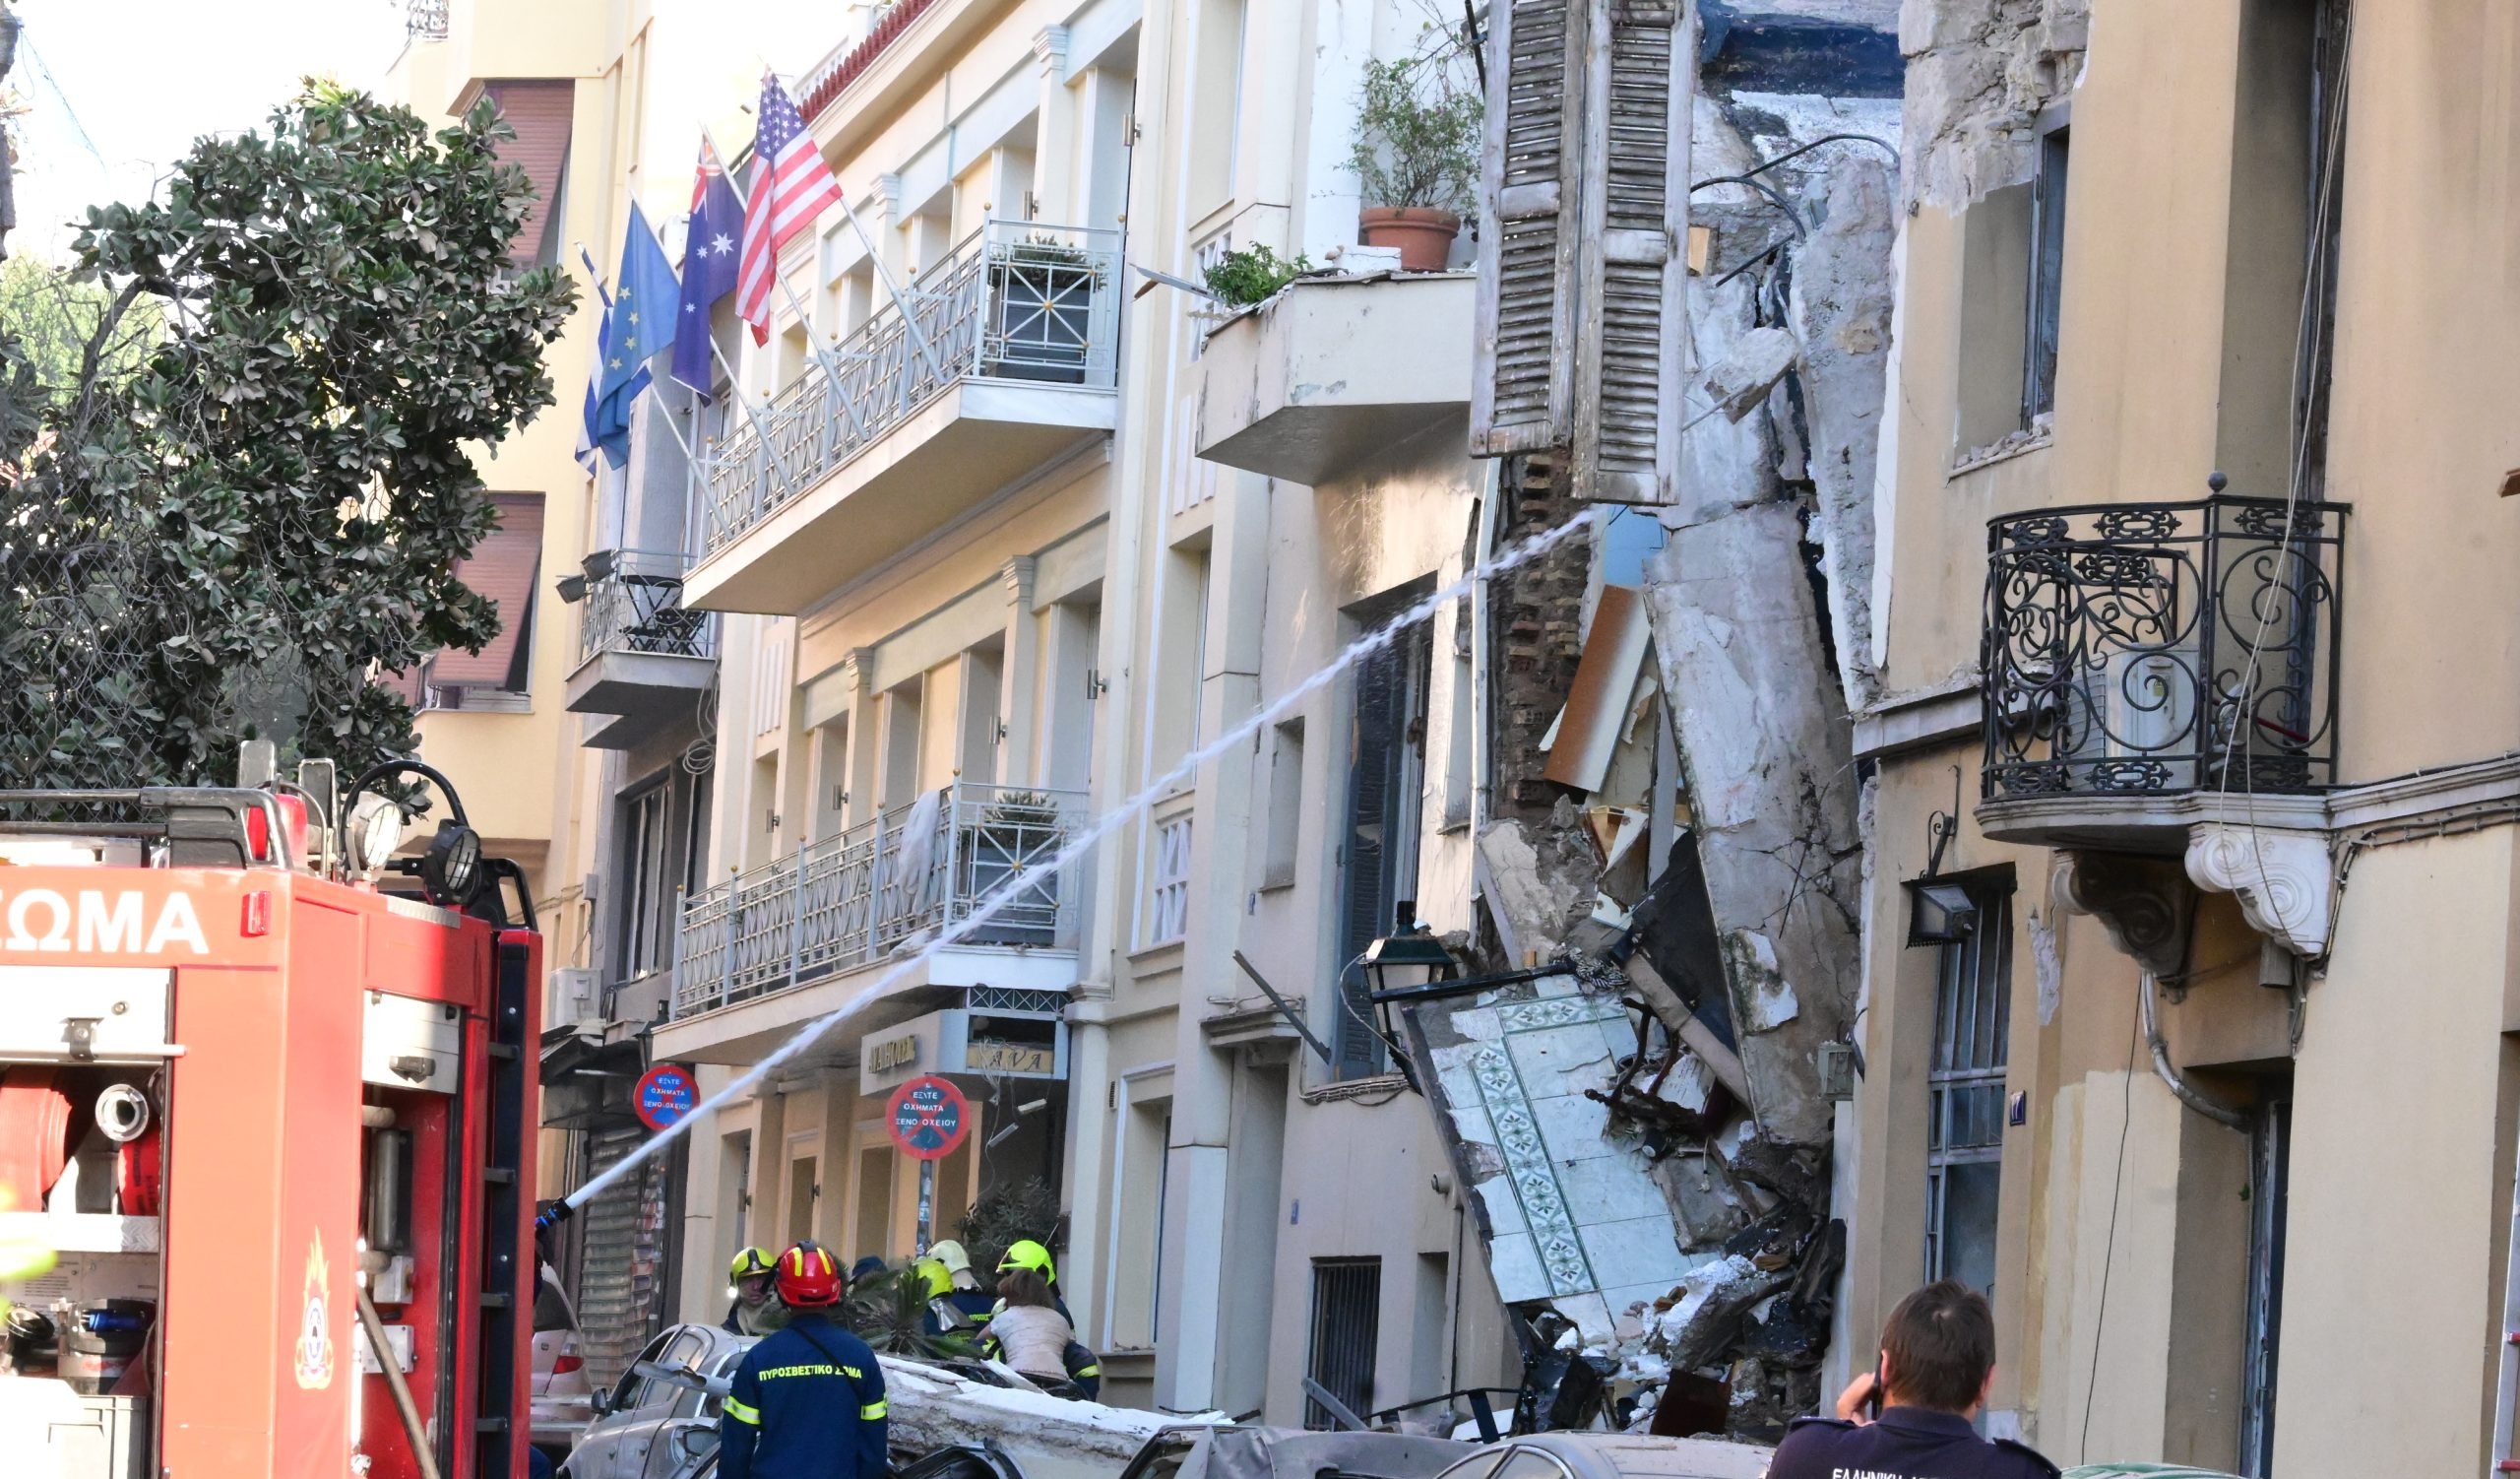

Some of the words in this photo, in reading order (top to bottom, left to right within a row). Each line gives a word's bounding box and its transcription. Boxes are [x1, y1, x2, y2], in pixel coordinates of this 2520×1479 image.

[0, 888, 210, 954] ΩΜΑ
[988, 1049, 1042, 1072] AVA
[651, 1087, 686, 1096] ΟΧΗΜΑΤΑ
[644, 1100, 691, 1110] ΞΕΝΟΟΧΕΙΟΥ
[903, 1103, 944, 1112] ΟΧΗΜΑΤΑ
[895, 1118, 957, 1127] ΞΕΝΟΟΧΕΙΟΥ
[758, 1365, 833, 1382] ΠΥΡΟΣΒΕΣΤΙΚΟ
[1832, 1467, 1904, 1479] ΕΛΛΗΝΙΚ
